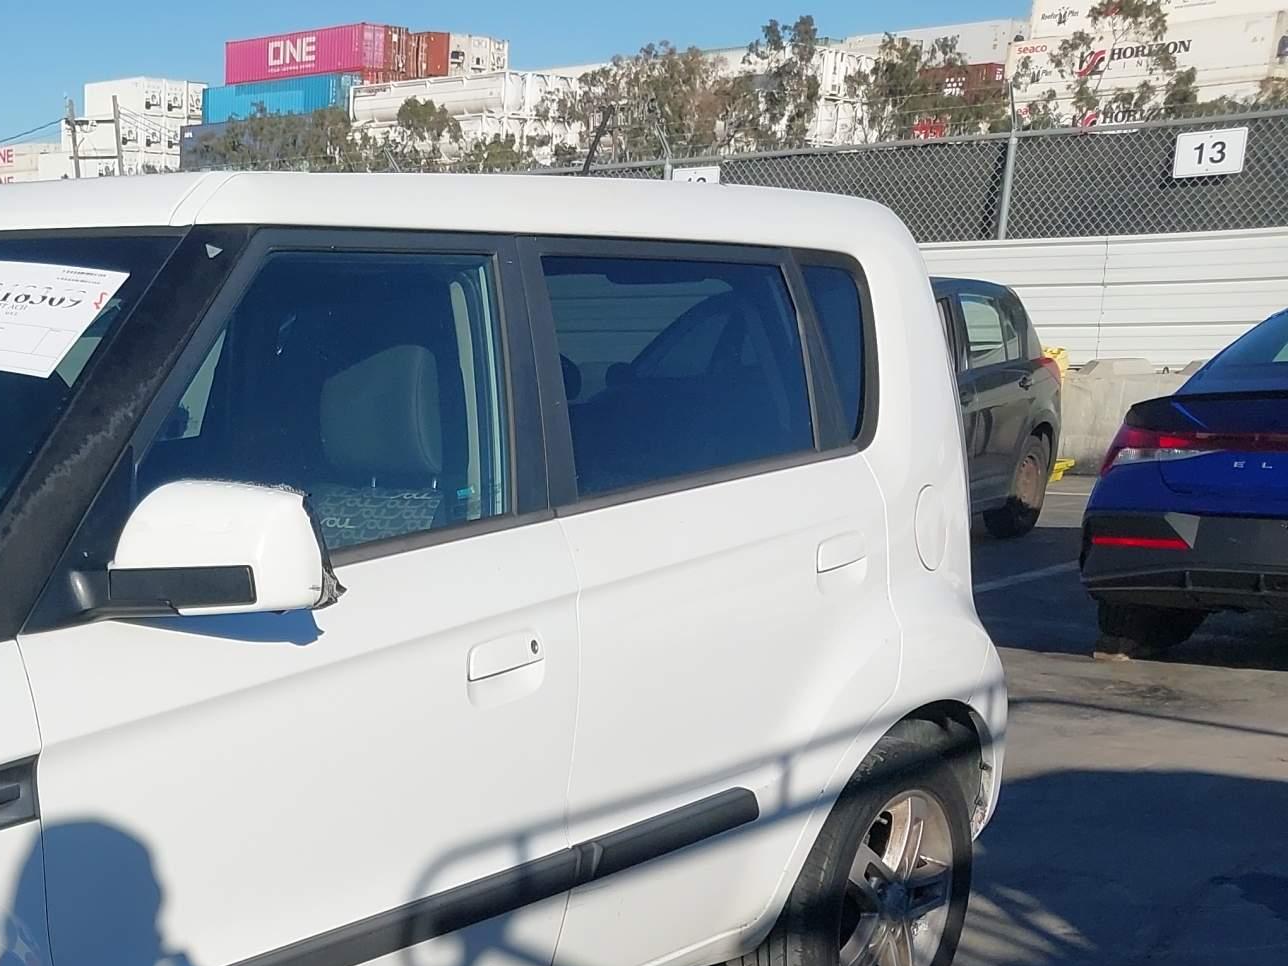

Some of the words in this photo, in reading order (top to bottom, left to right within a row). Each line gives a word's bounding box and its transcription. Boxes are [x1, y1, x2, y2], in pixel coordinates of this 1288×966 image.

[268, 37, 316, 66] ONE
[1016, 44, 1048, 54] seaco
[1111, 39, 1192, 61] HORIZON
[1193, 141, 1228, 165] 13
